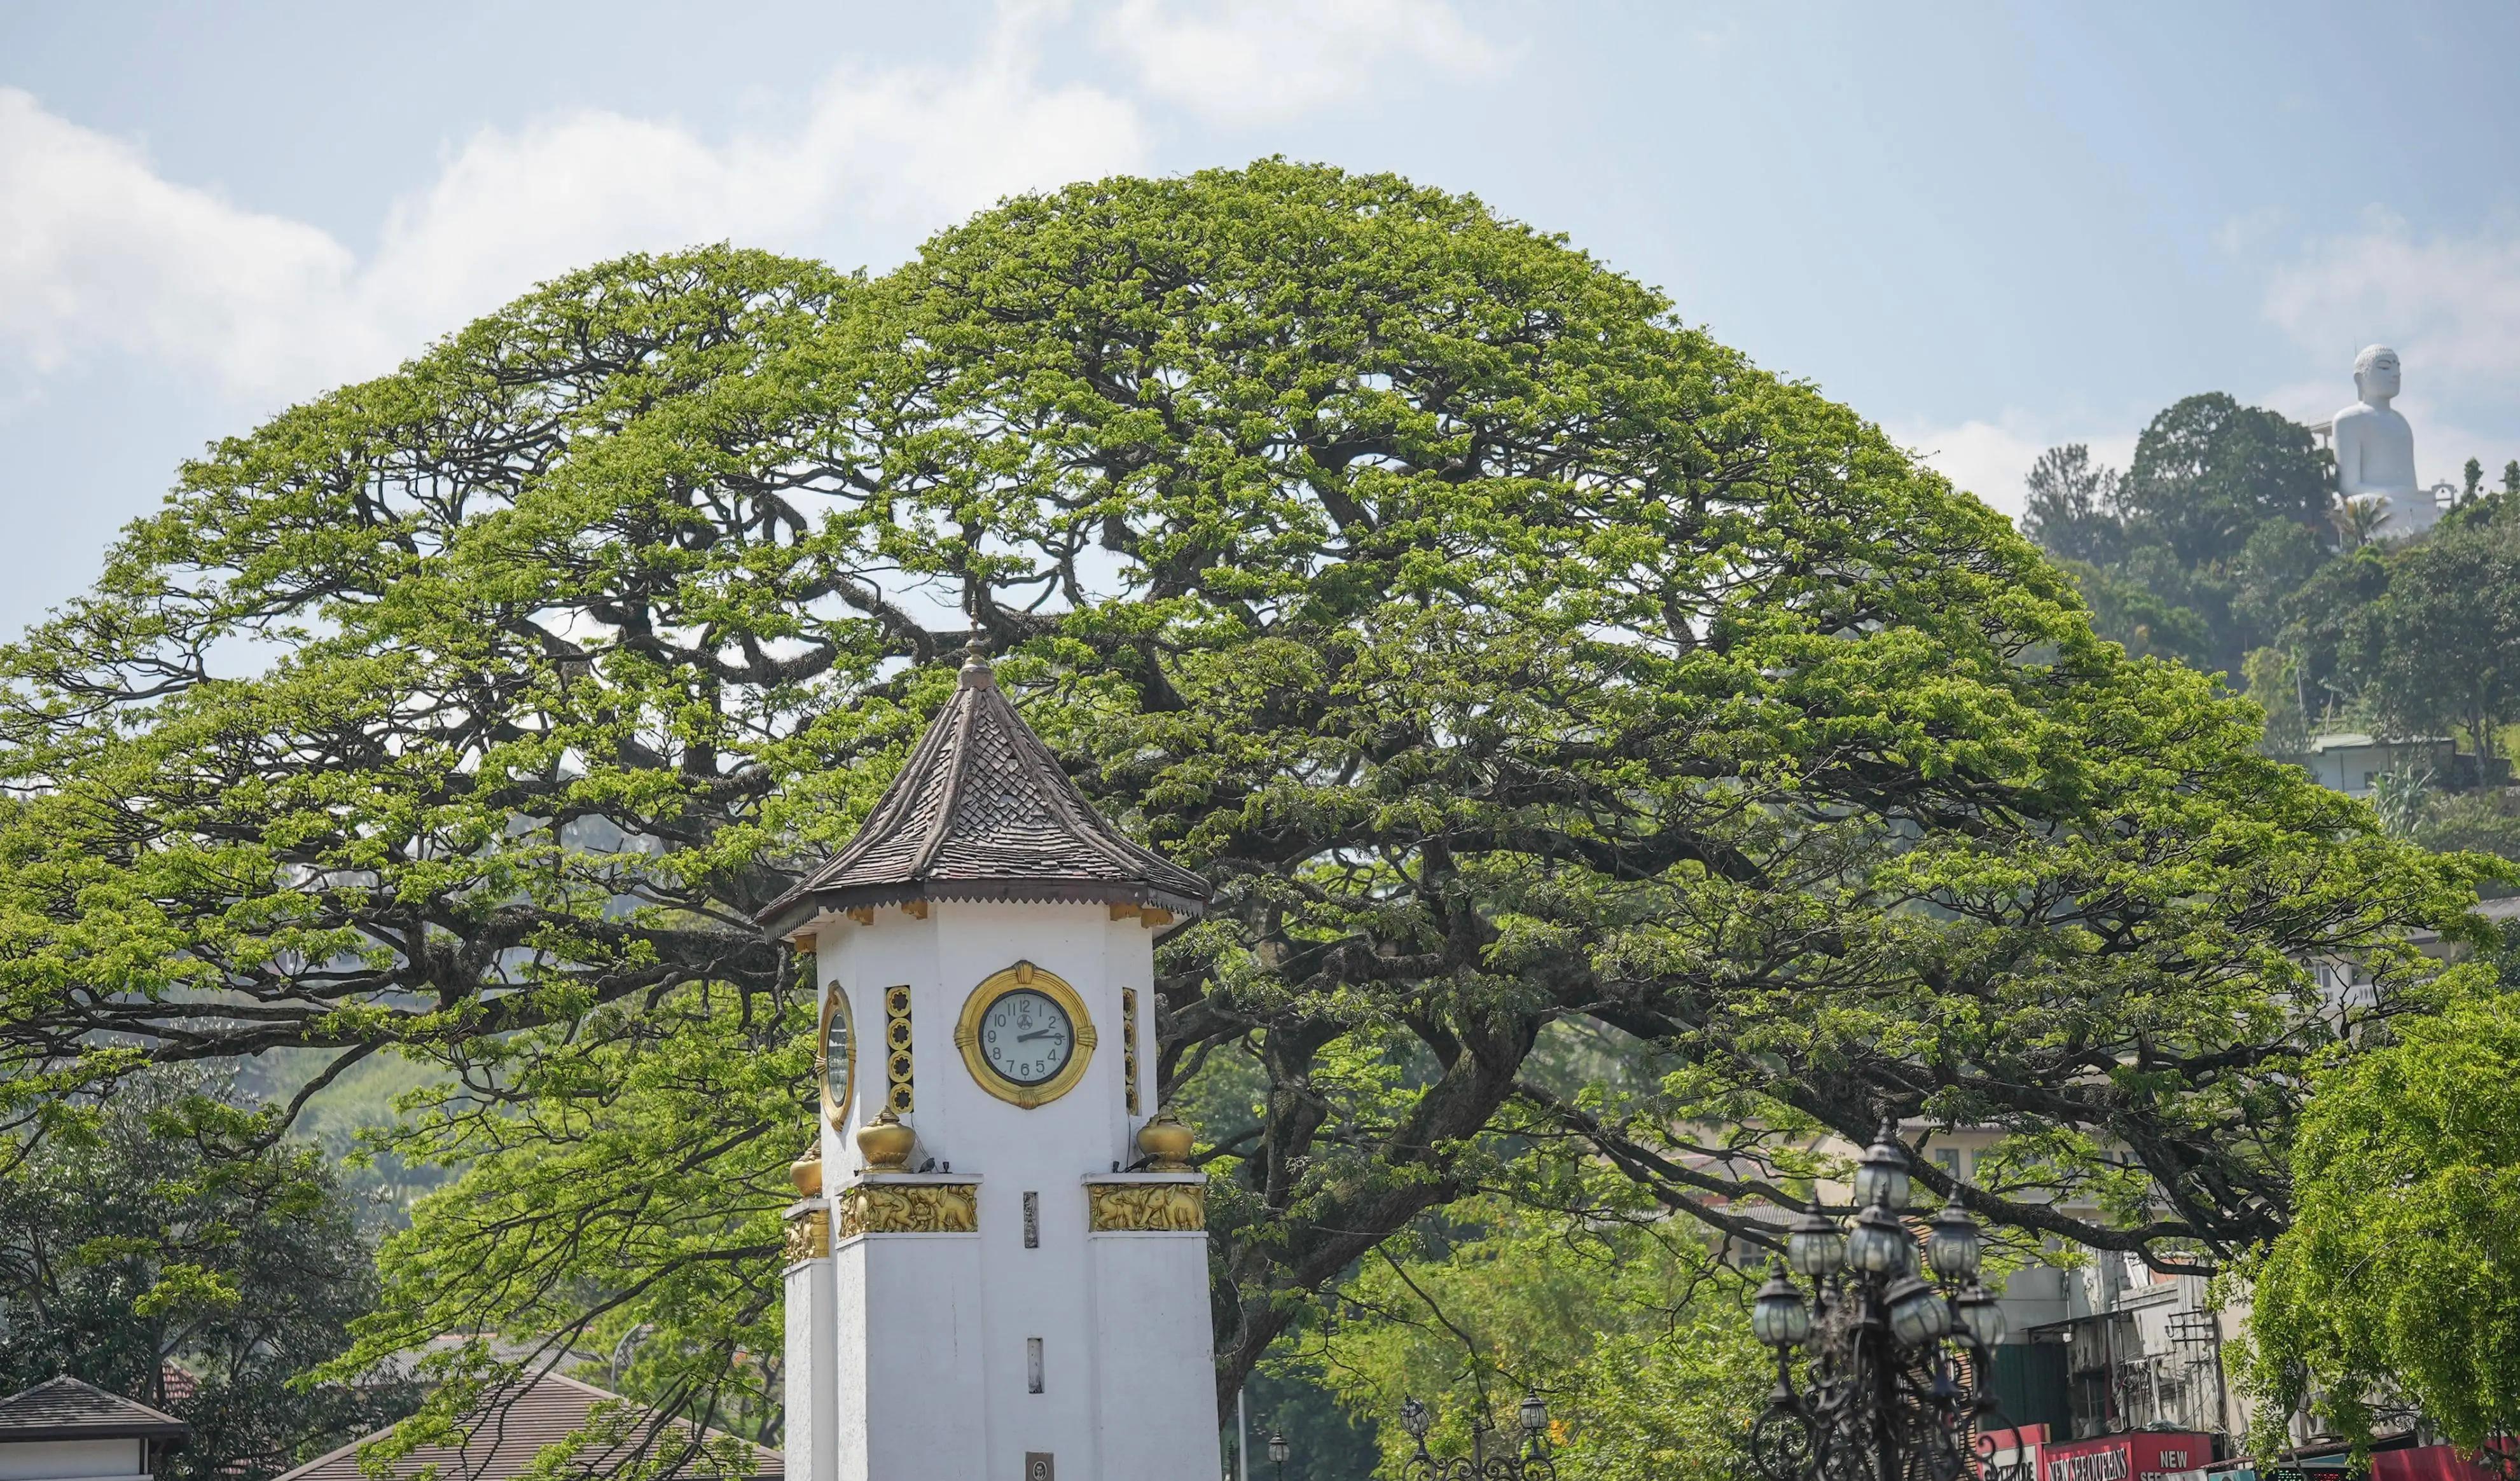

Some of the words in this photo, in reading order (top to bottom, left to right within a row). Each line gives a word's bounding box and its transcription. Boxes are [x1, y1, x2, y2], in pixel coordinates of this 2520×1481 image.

[1007, 1003, 1016, 1016] 11
[1020, 999, 1030, 1013] 12
[994, 1014, 1006, 1027] 10
[1048, 1016, 1056, 1029] 2
[987, 1030, 996, 1043] 9
[1053, 1033, 1062, 1045] 3
[993, 1047, 1001, 1060] 8
[1048, 1049, 1056, 1061] 4
[1006, 1060, 1014, 1073] 7
[1020, 1063, 1029, 1076] 6
[1036, 1060, 1044, 1073] 5
[2160, 1450, 2187, 1468] NEW
